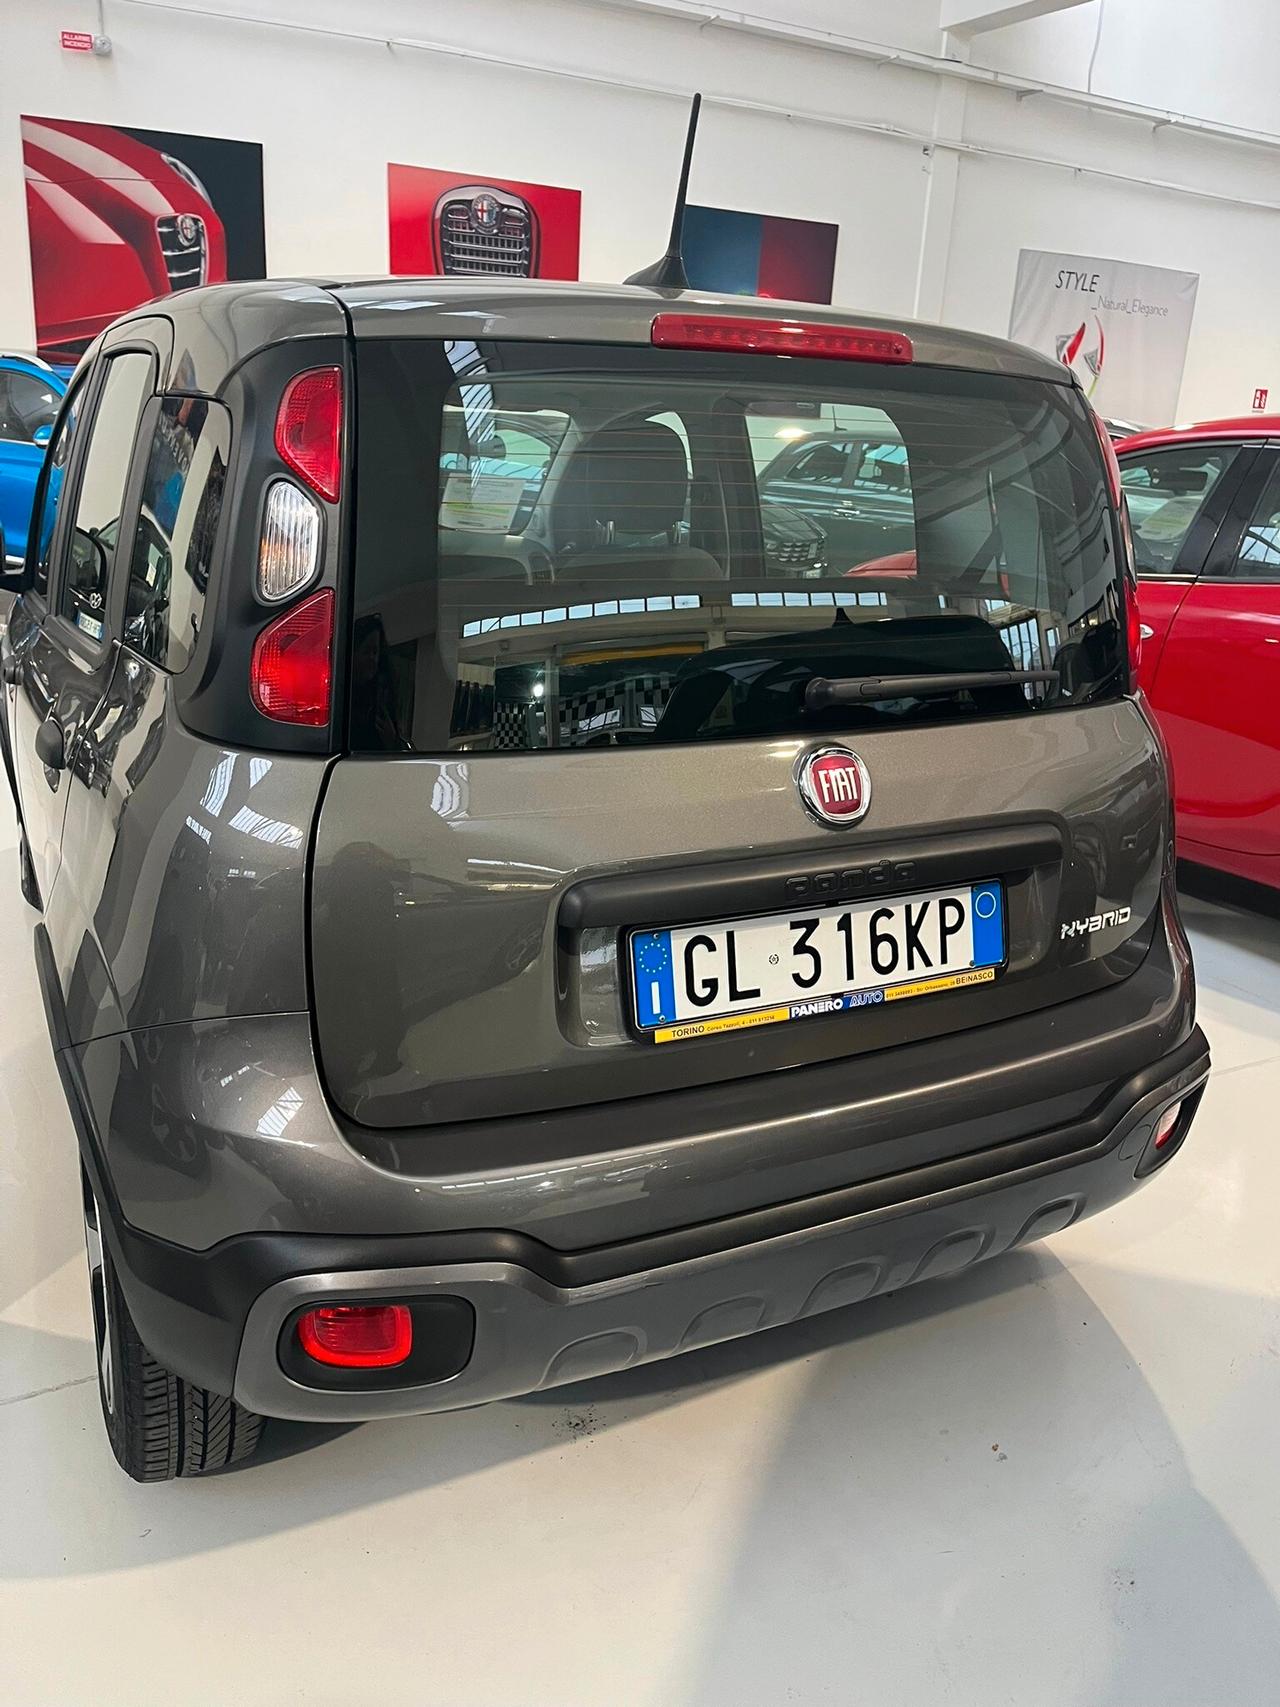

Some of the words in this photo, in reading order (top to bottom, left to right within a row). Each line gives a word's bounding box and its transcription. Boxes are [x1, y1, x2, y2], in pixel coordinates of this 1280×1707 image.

[1055, 270, 1100, 293] STYLE
[818, 766, 858, 803] FIAT
[784, 860, 915, 897] panda
[1060, 906, 1132, 940] HYBRID
[684, 930, 761, 1007] GL
[789, 897, 966, 989] 316KP
[956, 971, 994, 984] BEINASCO
[791, 998, 844, 1018] PANERO
[849, 991, 883, 1008] AUTO
[671, 1025, 705, 1038] TORINO
